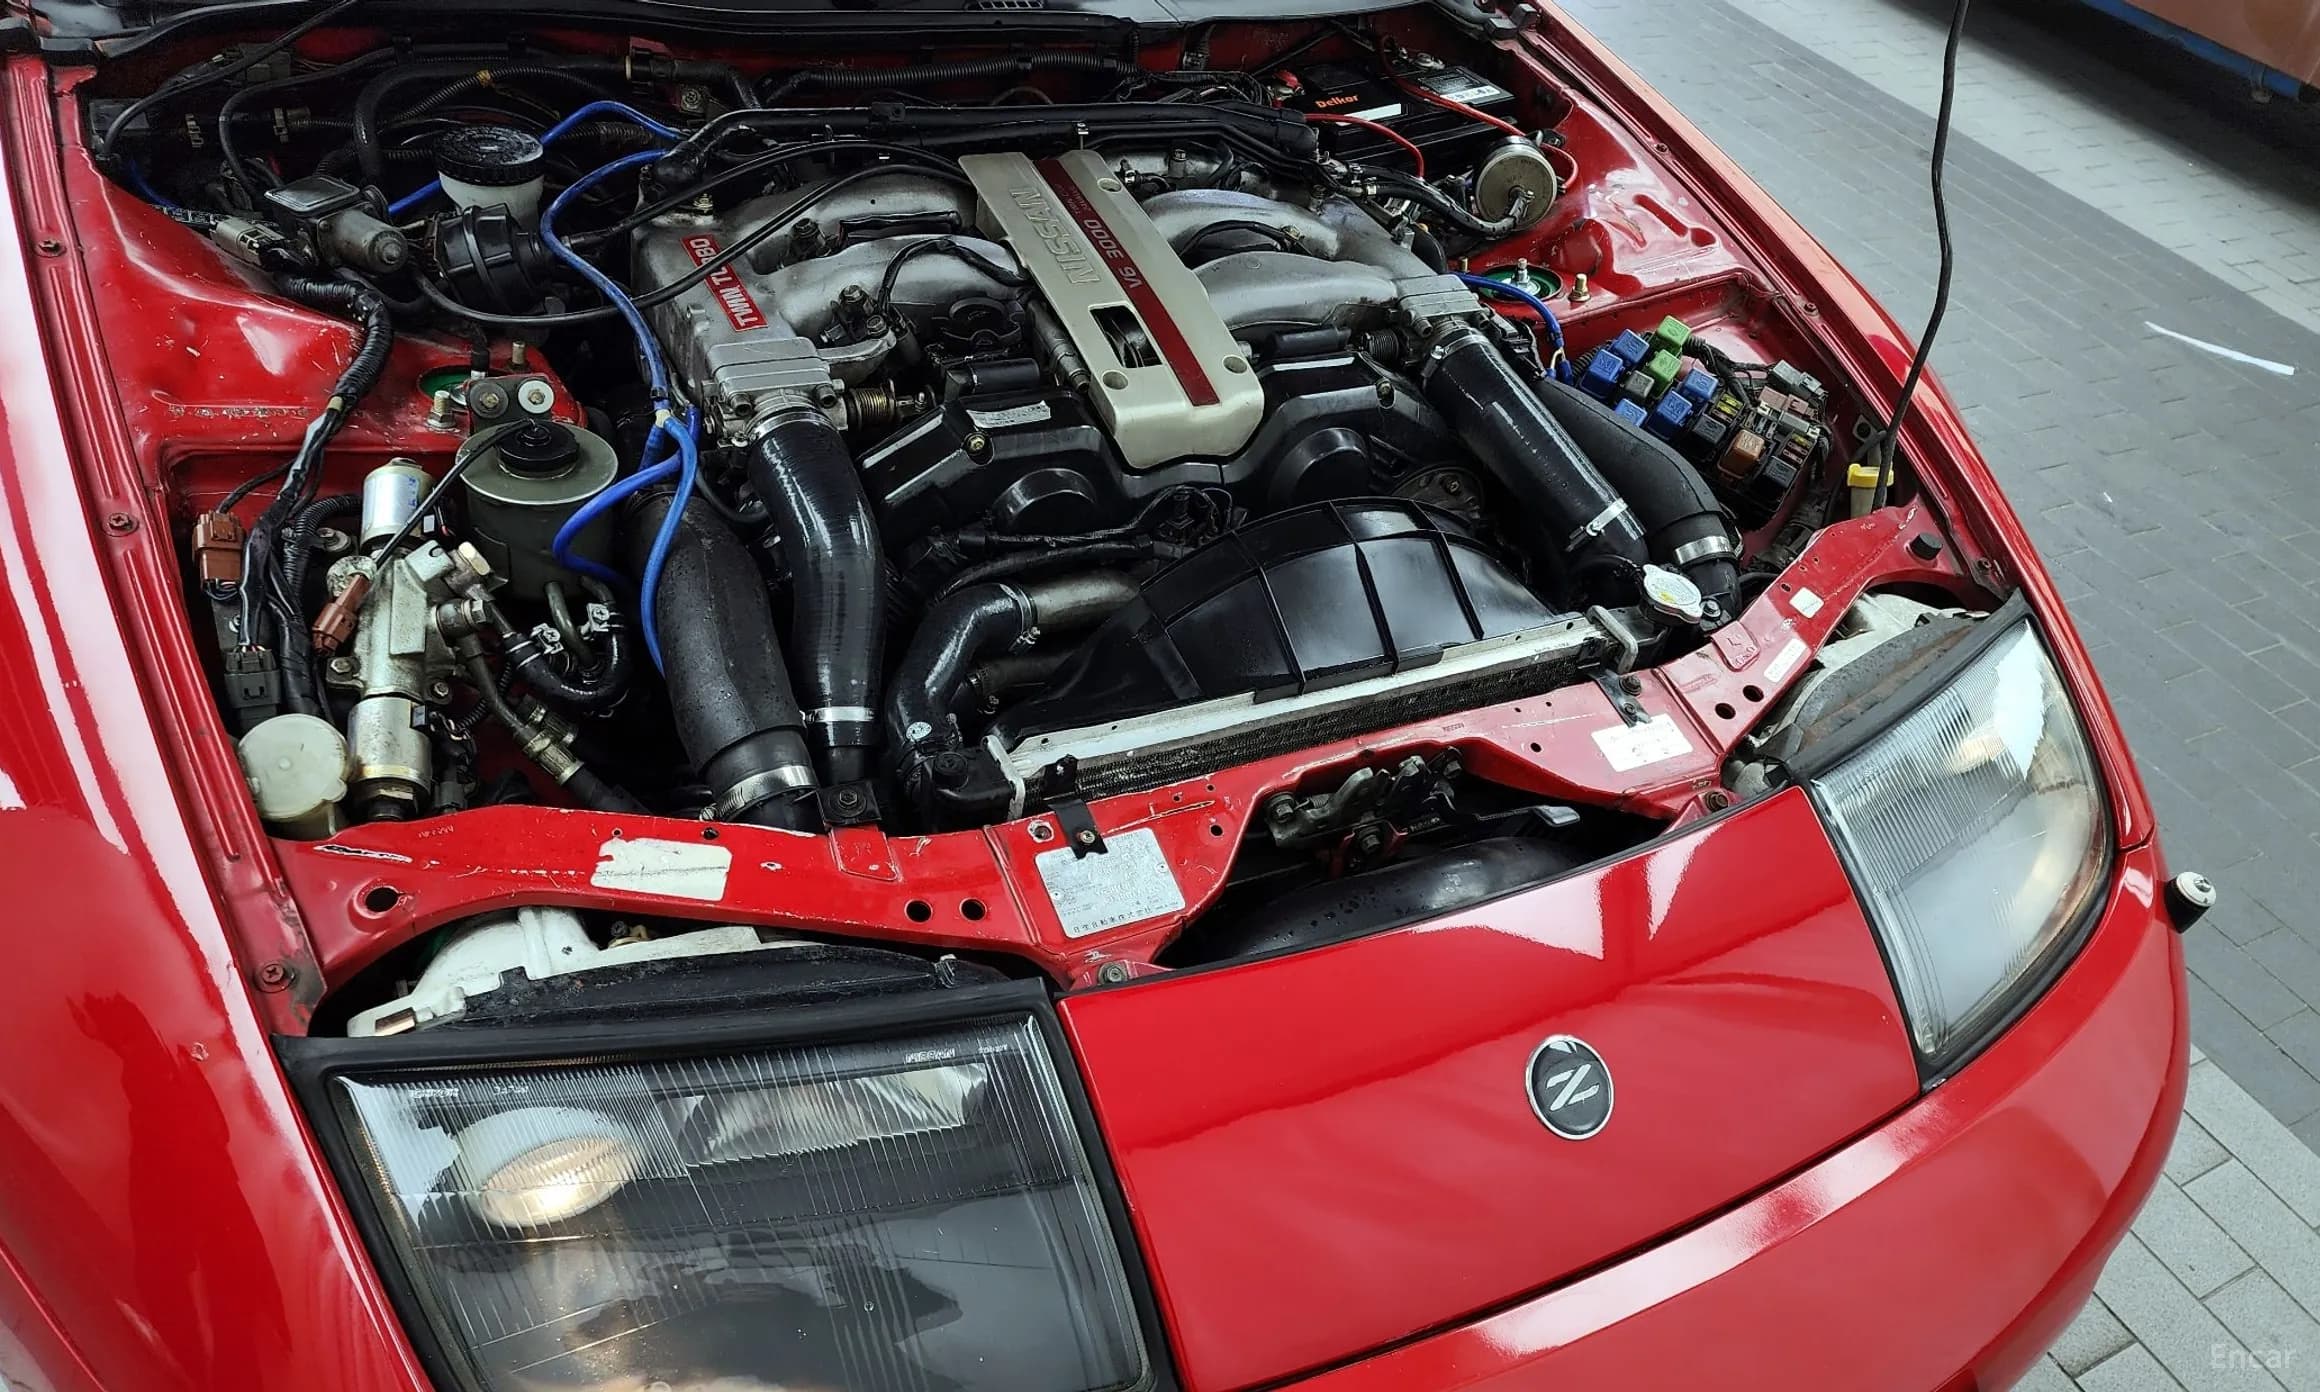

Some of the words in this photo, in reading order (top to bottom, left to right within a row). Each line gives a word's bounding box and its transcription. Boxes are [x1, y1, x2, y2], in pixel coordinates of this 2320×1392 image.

[1009, 186, 1101, 285] NISSAN
[1083, 218, 1125, 260] 3000
[1119, 265, 1143, 289] V6
[719, 285, 759, 327] TWIN
